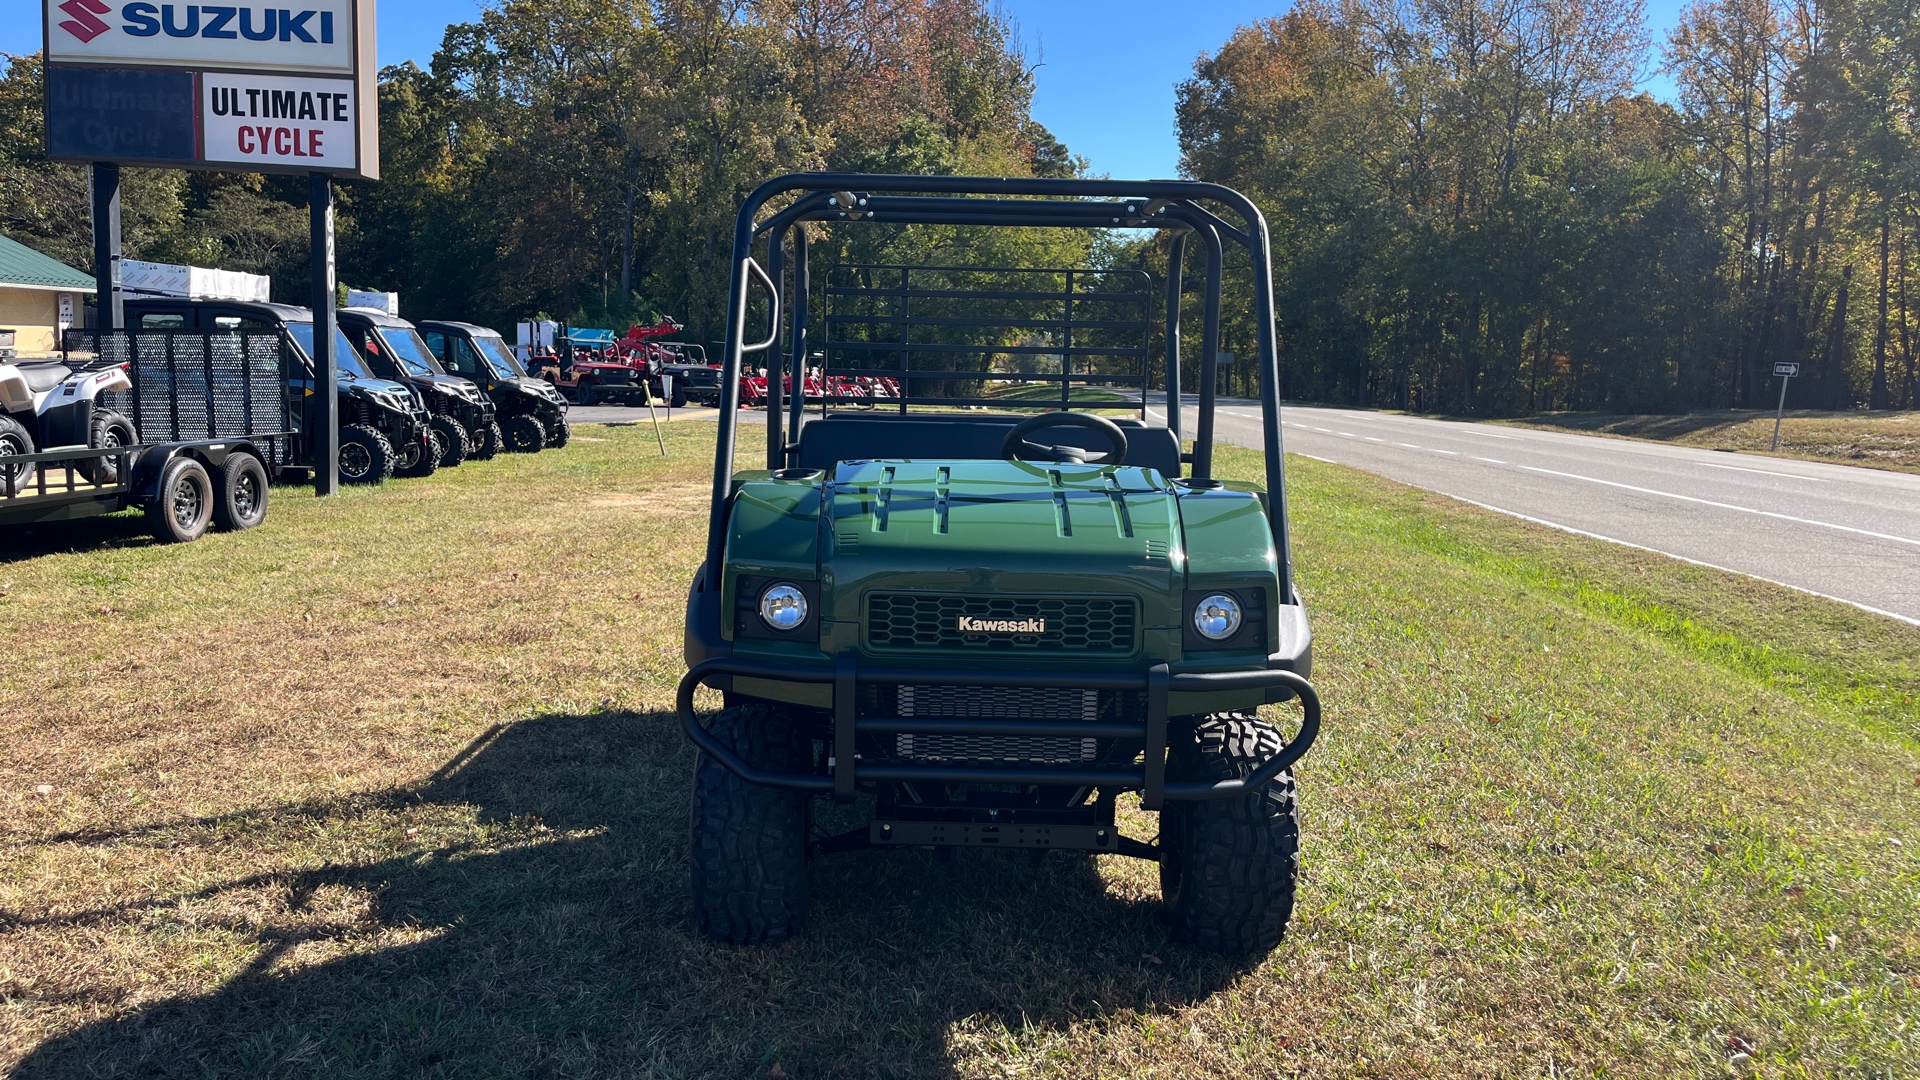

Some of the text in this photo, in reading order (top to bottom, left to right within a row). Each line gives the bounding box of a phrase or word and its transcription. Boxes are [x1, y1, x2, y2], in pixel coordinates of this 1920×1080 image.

[121, 2, 333, 44] SUZUKI
[211, 87, 348, 122] ULTIMATE
[238, 125, 324, 157] CYCLE
[326, 205, 336, 292] 820
[959, 616, 1045, 633] Kawasaki
